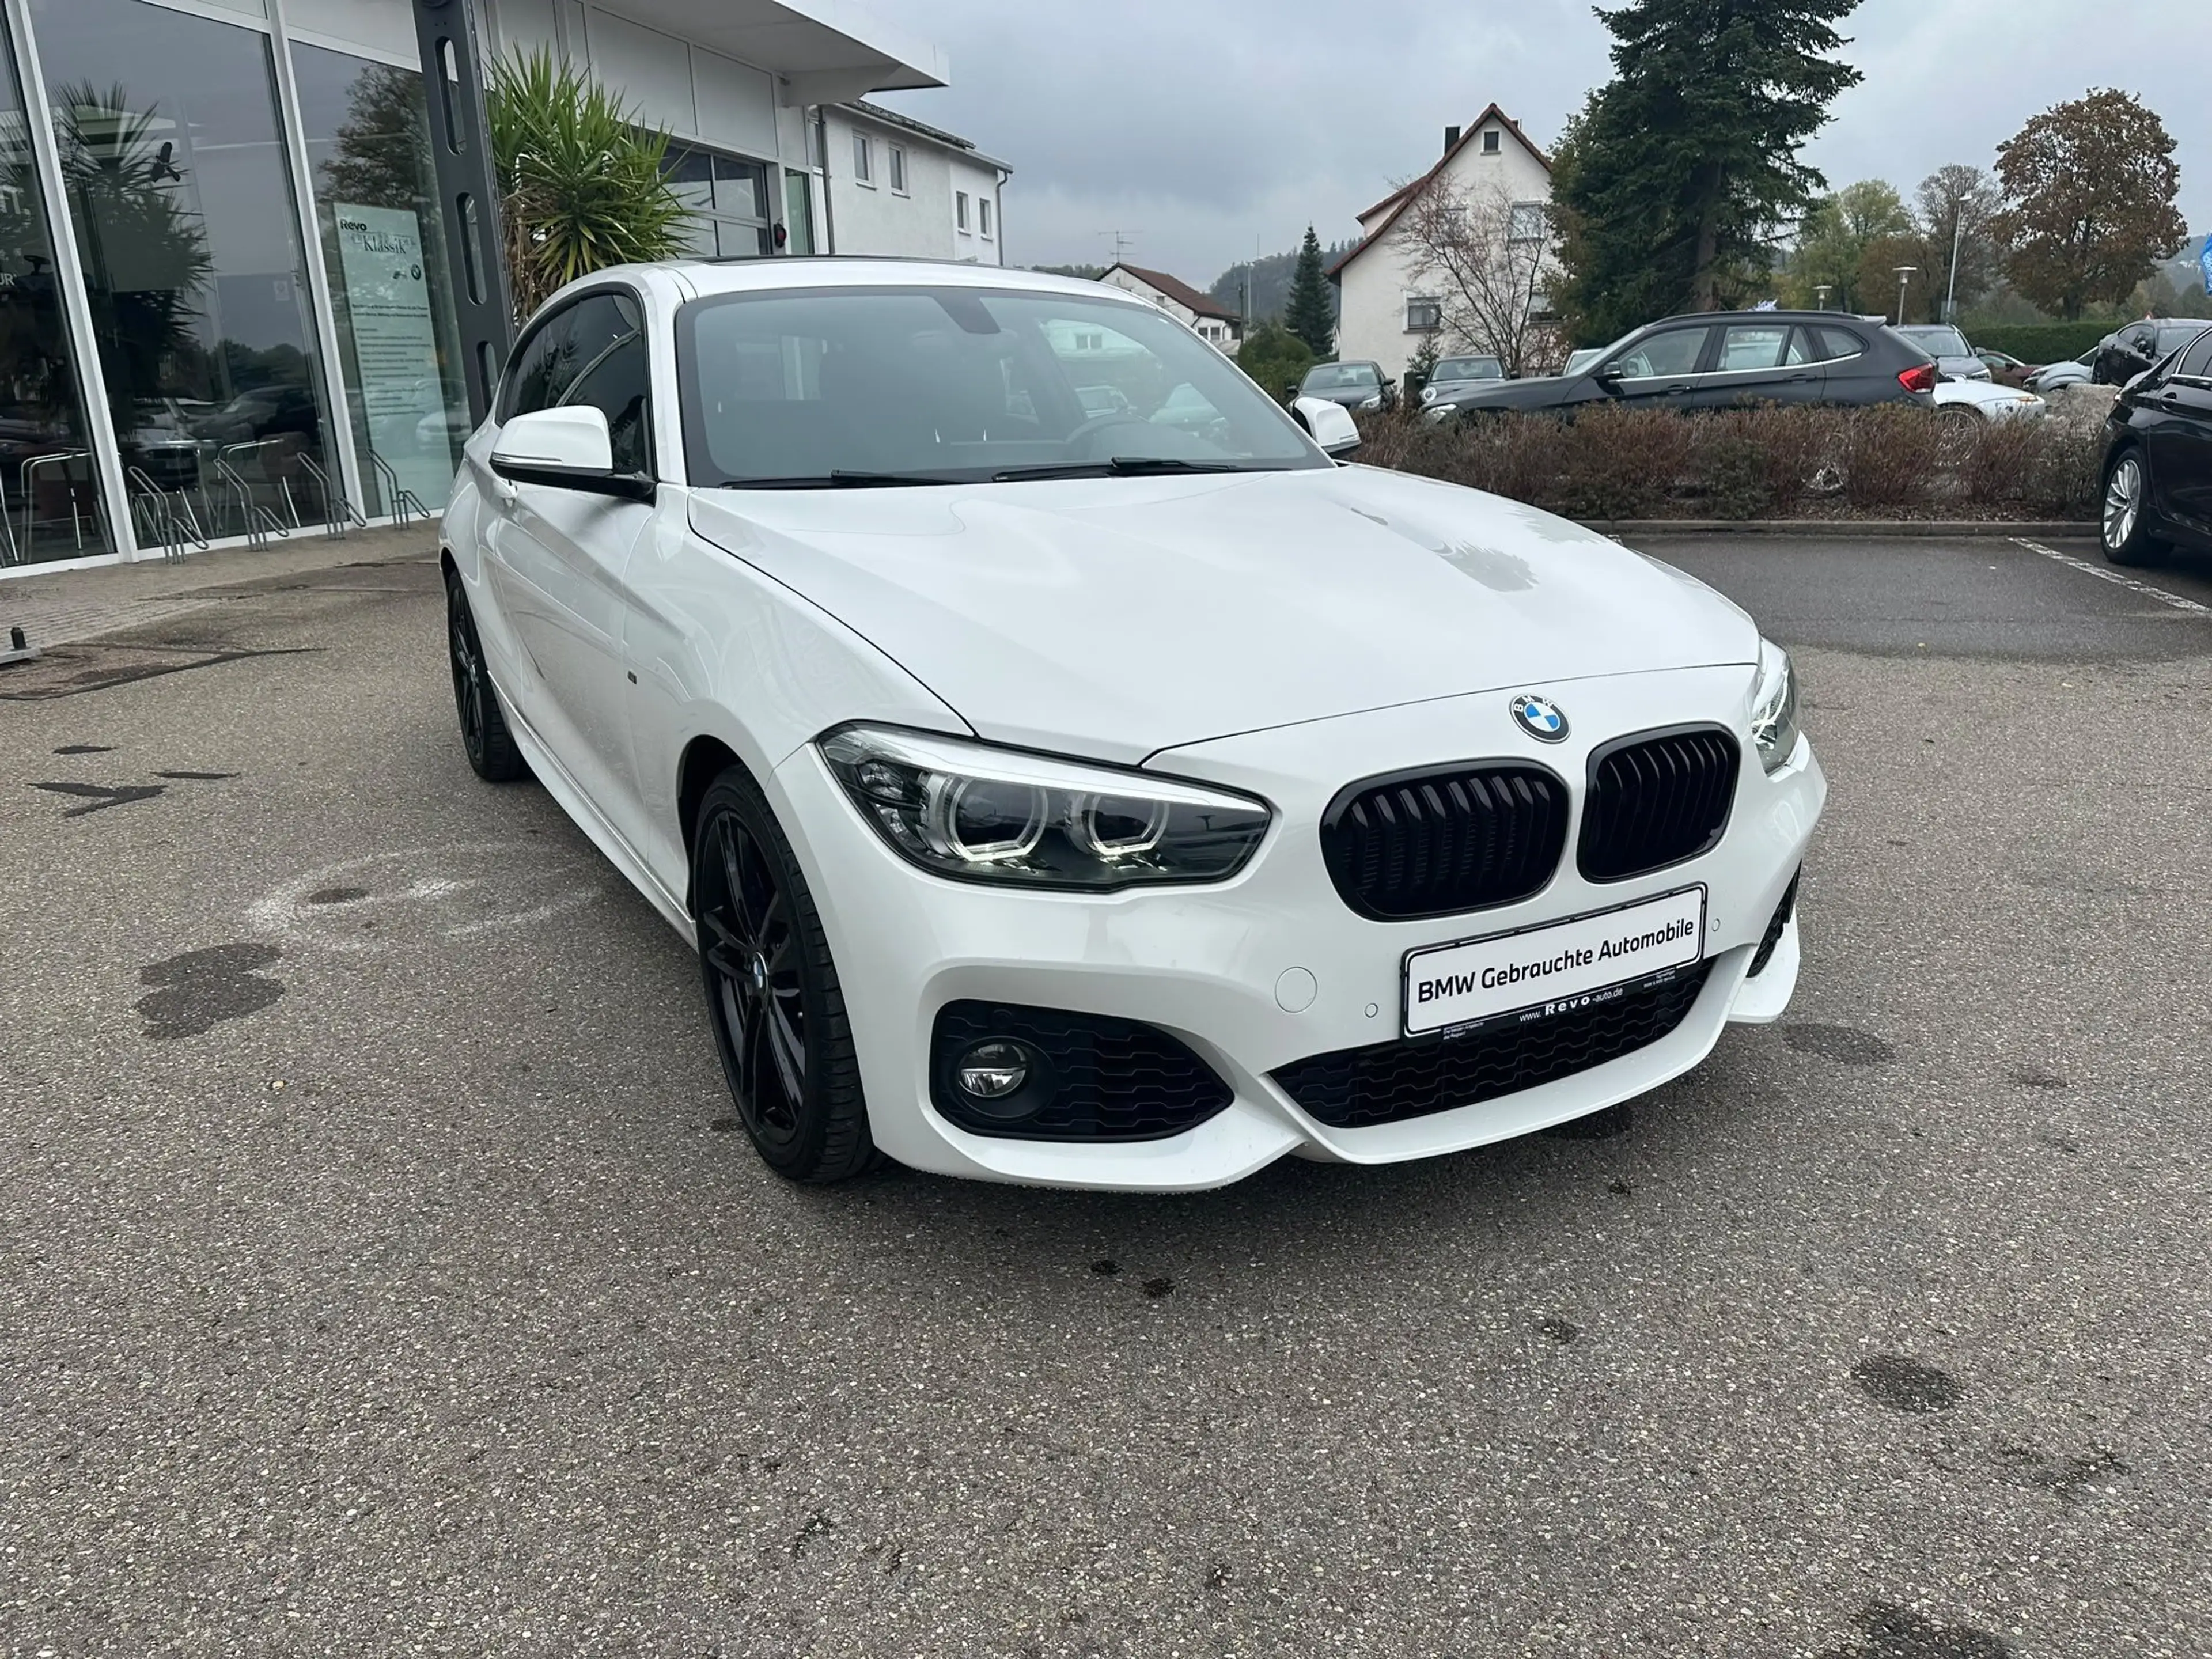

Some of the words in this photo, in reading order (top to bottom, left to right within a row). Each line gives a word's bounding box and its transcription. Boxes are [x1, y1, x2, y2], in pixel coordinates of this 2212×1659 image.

[340, 219, 367, 231] Revo
[363, 235, 406, 254] Klassik
[1418, 971, 1475, 1003] BMW
[1481, 949, 1593, 989] Gebrauchte
[1597, 918, 1694, 961] Automobile
